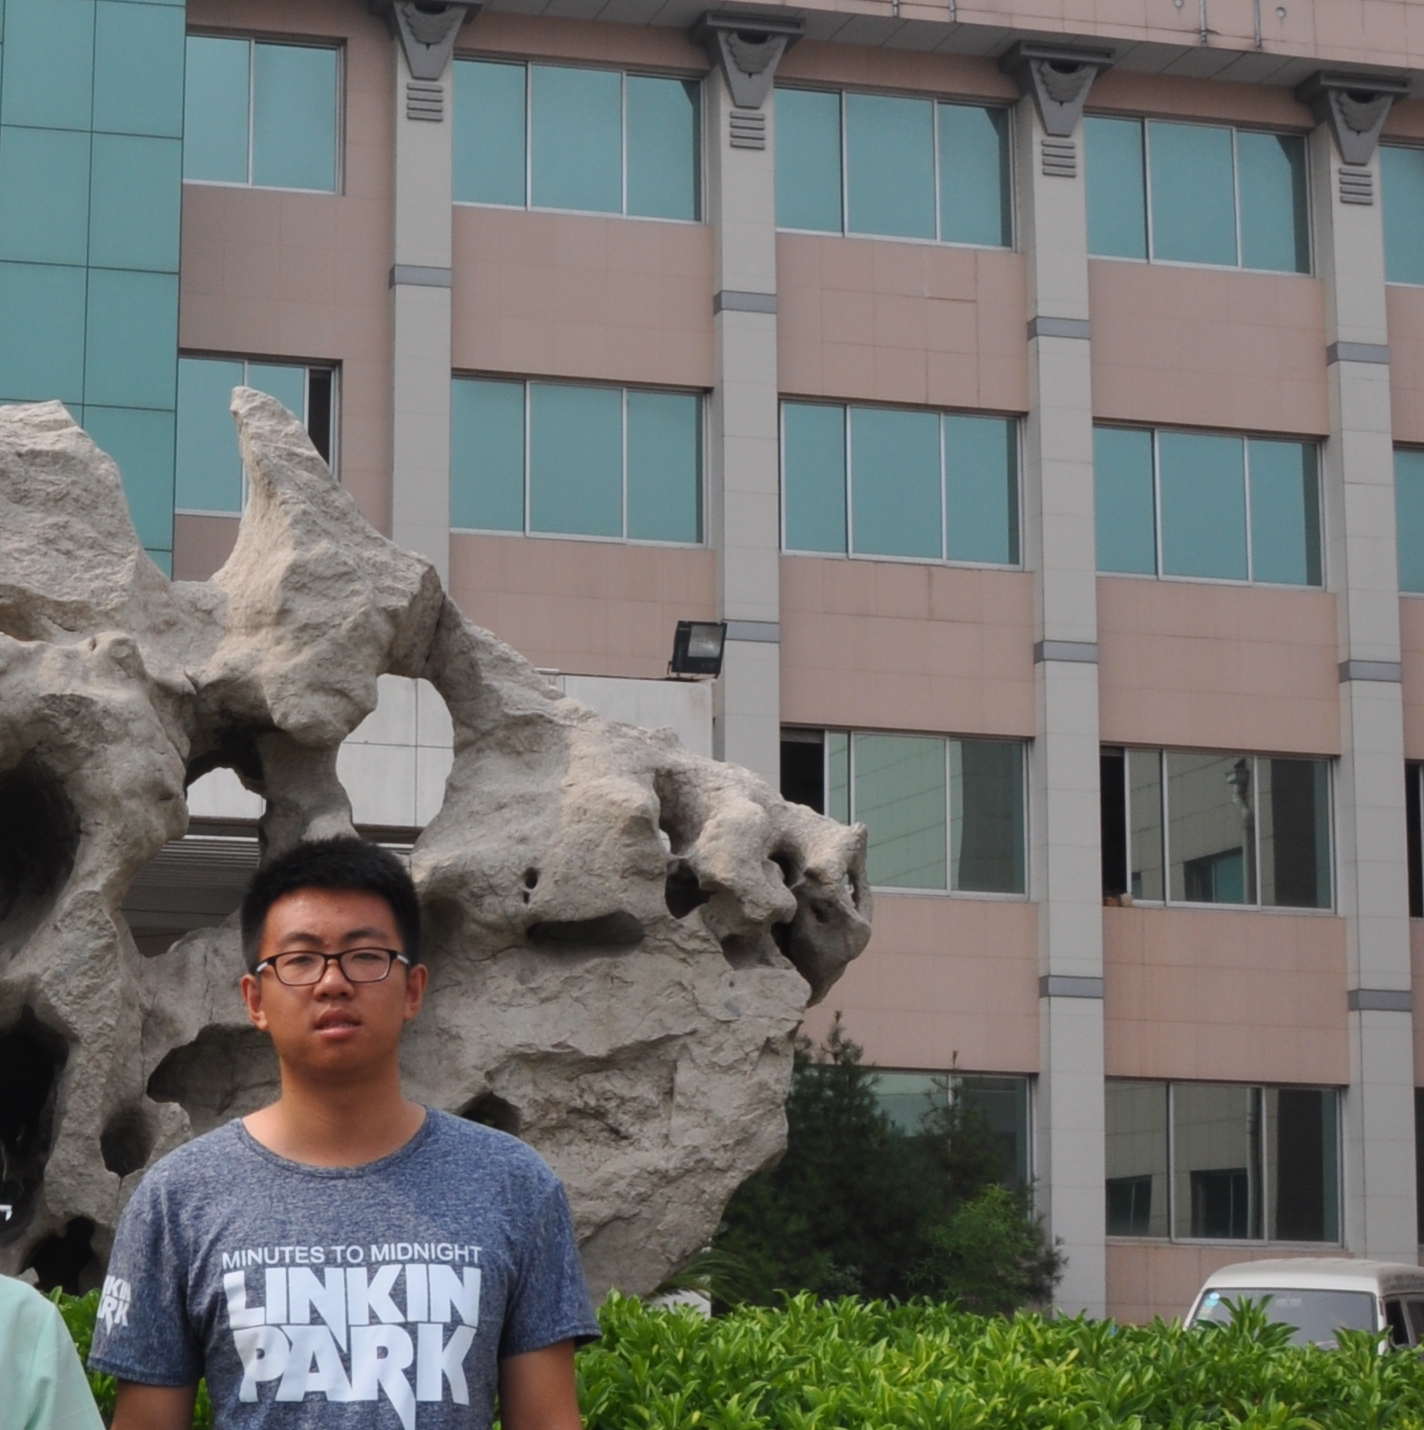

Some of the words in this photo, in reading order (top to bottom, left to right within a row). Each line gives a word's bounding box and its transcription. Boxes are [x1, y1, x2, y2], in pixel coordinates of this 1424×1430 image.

[222, 1245, 325, 1269] MINUTES
[331, 1245, 364, 1263] TO
[371, 1242, 483, 1263] MIDNIGHT
[223, 1263, 482, 1354] LINKIN
